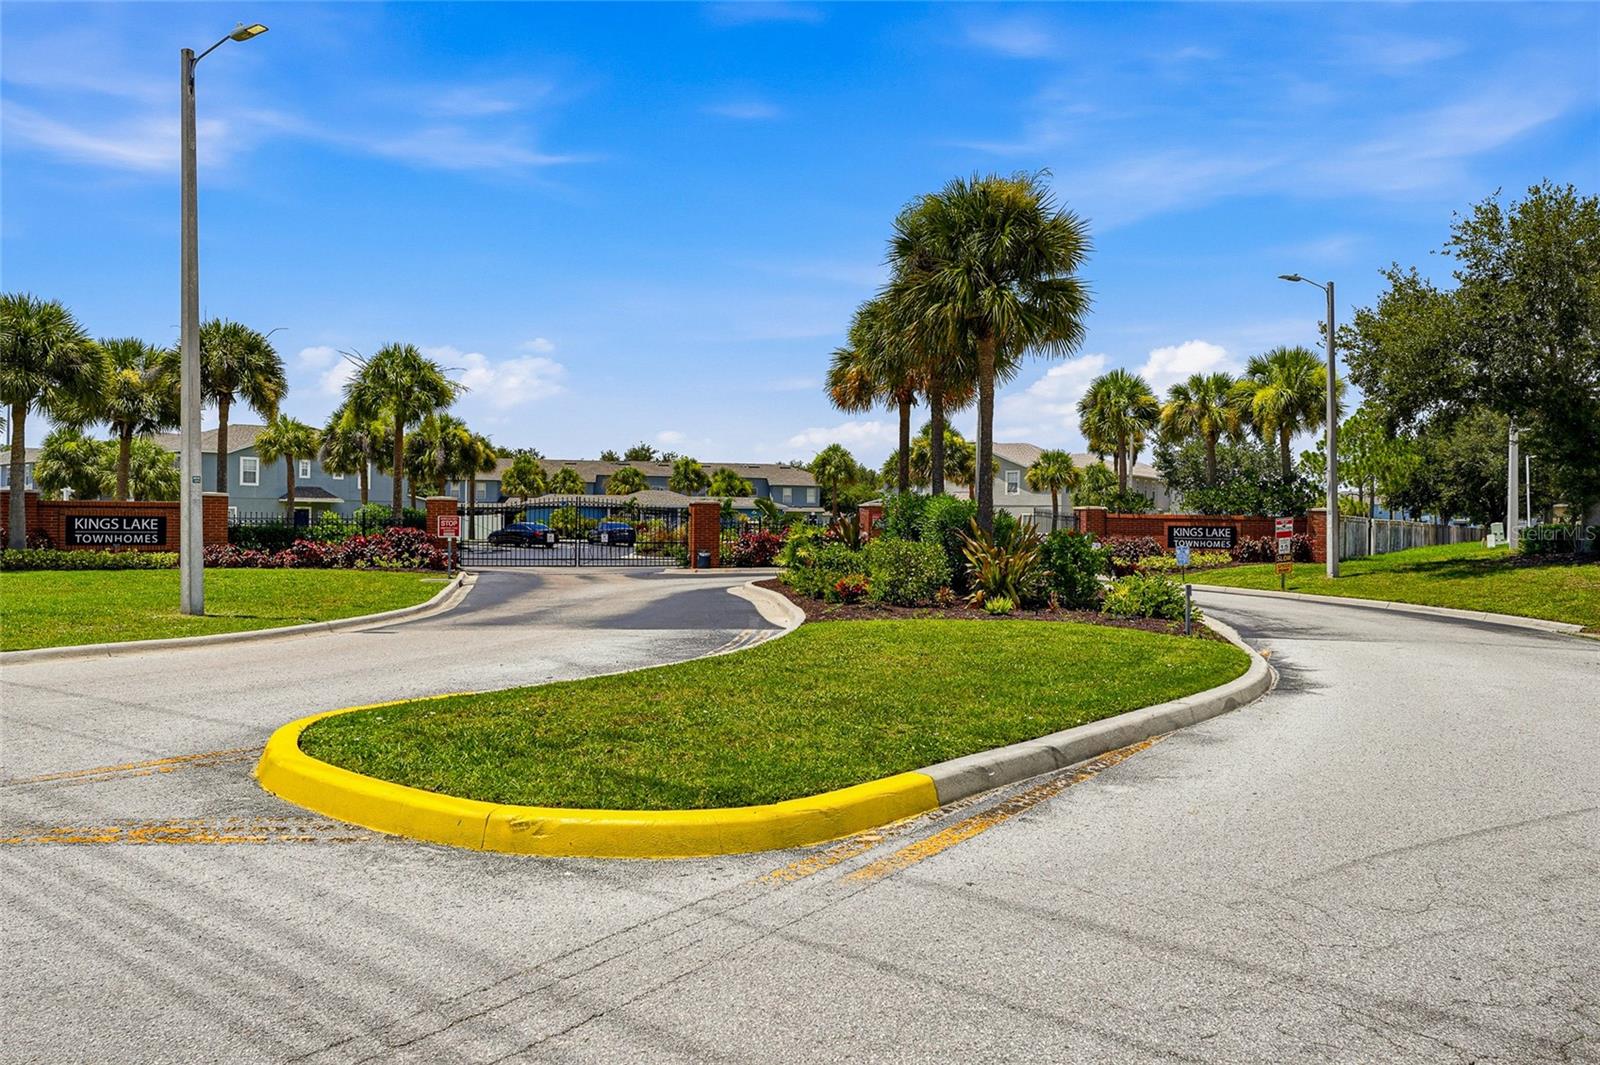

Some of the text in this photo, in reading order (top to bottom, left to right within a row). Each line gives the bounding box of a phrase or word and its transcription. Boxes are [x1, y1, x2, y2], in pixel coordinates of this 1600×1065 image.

[74, 518, 159, 530] KINGS LAKE
[1173, 527, 1231, 538] KINGS LAKE
[74, 534, 159, 544] TOWNHOMES
[1174, 539, 1231, 548] TOWNHOMES
